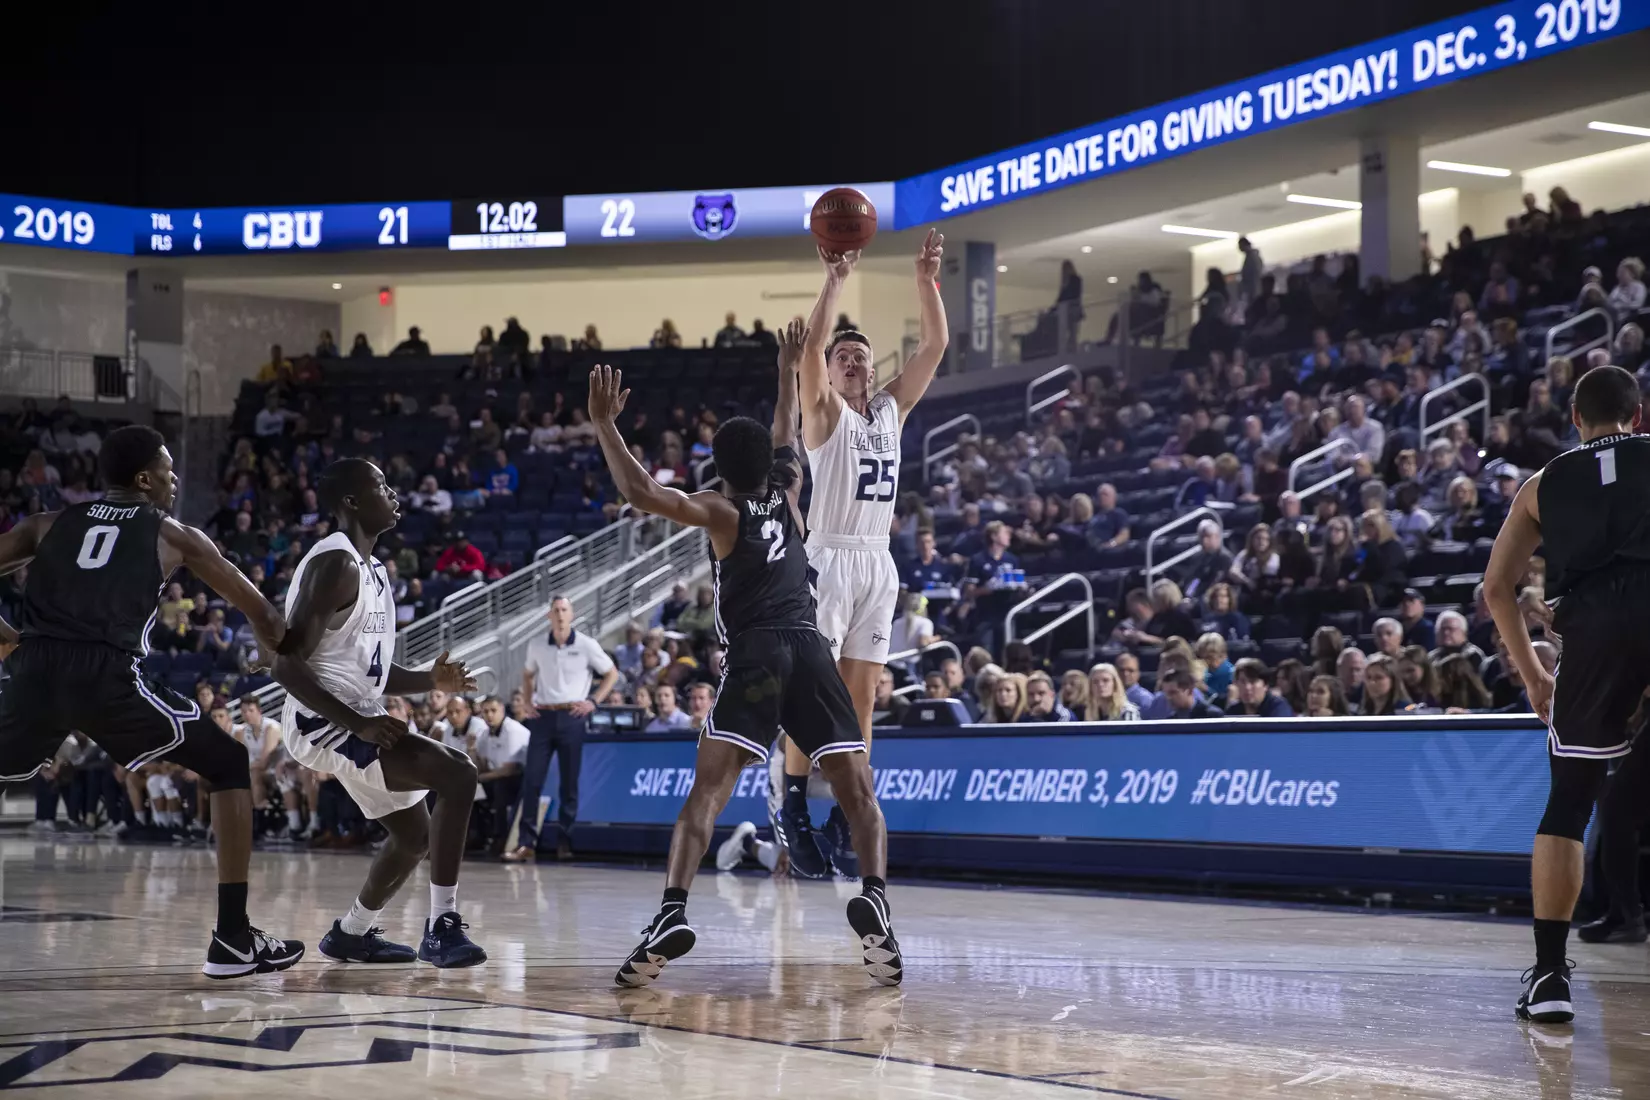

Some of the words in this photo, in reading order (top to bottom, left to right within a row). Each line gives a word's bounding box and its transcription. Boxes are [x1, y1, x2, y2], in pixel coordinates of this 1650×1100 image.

[941, 165, 994, 212] SAVE
[998, 151, 1041, 196] THE
[1045, 133, 1103, 184] DATE
[1108, 119, 1157, 166] FOR
[1162, 90, 1253, 151] GIVING
[1258, 47, 1398, 124] TUESDAY!
[1413, 26, 1487, 83] DEC.
[1494, 14, 1527, 61] 3,
[1535, 0, 1621, 48] 2019
[13, 205, 95, 245] 2019
[242, 210, 323, 249] CBU
[378, 206, 408, 245] 21
[477, 201, 537, 233] 12:02
[600, 199, 636, 237] 22
[972, 278, 988, 352] CBU
[856, 458, 895, 502] 25
[1595, 447, 1617, 485] 1
[87, 503, 140, 520] SHITTU
[76, 525, 120, 569] 0
[761, 519, 787, 564] 2
[366, 640, 382, 687] 4
[630, 767, 675, 797] SAVE
[672, 767, 696, 797] TH
[873, 768, 958, 801] UESDAY!
[965, 768, 1087, 803] DECEMBER
[1088, 769, 1110, 808] 3,
[1114, 768, 1179, 804] 2019
[1190, 769, 1340, 808] #CBUcares
